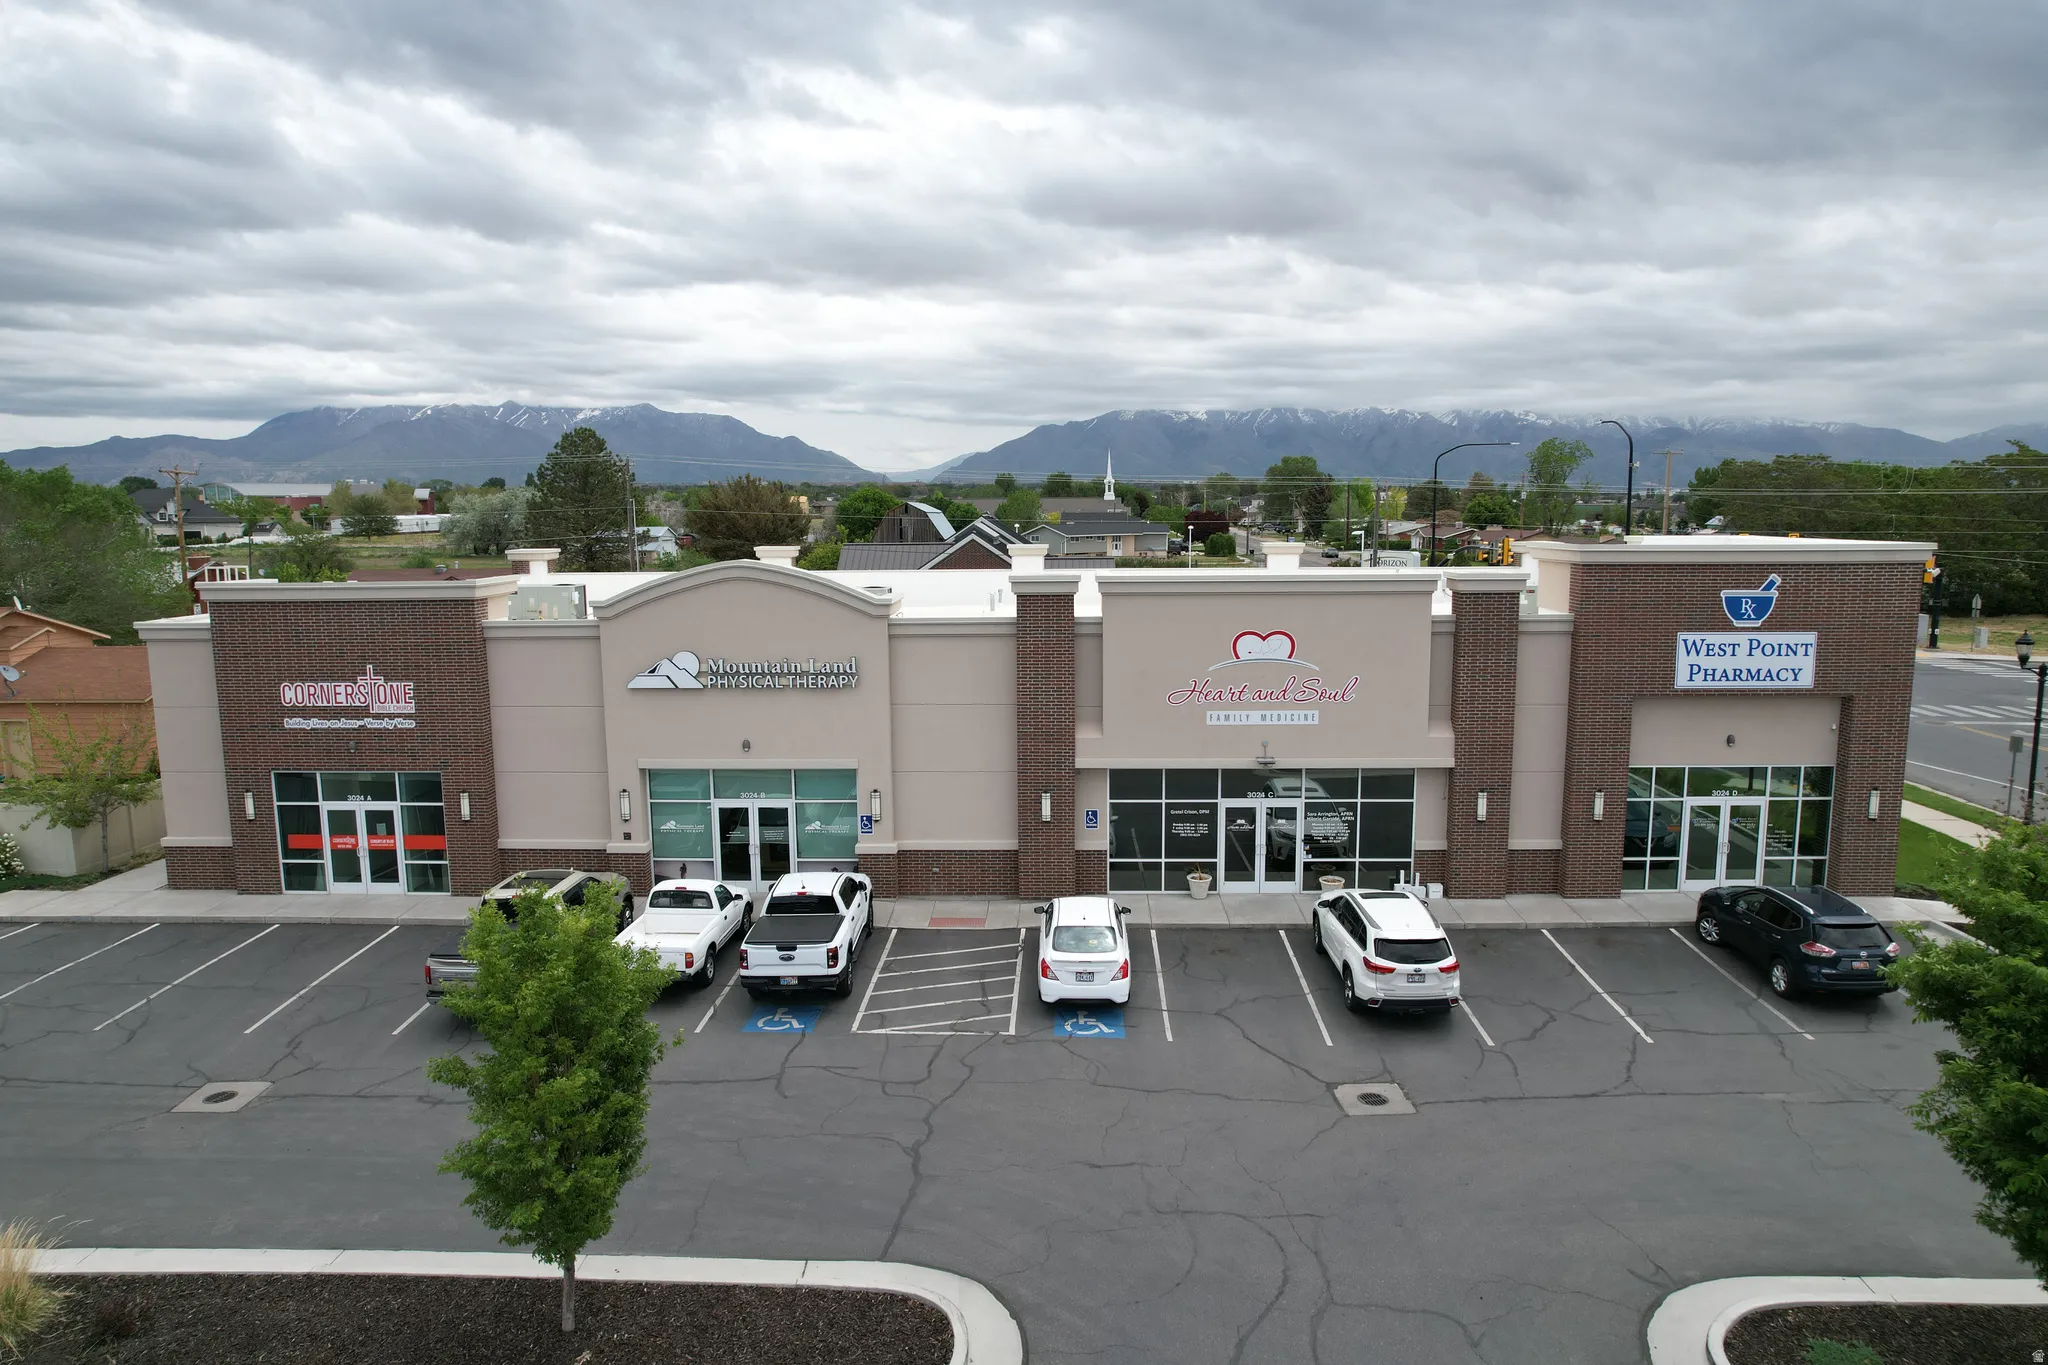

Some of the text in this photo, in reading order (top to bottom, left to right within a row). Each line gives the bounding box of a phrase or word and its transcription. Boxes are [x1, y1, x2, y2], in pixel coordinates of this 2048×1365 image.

[1377, 559, 1408, 567] ORIZON
[1681, 638, 1813, 657] WEST POINT
[706, 656, 857, 674] Mountain Land
[1687, 663, 1803, 682] PHARMACY
[707, 675, 859, 689] PHYSICAL THERAPY
[1167, 675, 1360, 706] Heart and Soul
[285, 718, 311, 729] Building
[312, 719, 328, 728] Lives
[340, 719, 358, 728] Jesus
[366, 719, 384, 728] Verse
[385, 719, 395, 730] by
[396, 719, 415, 728] Verse
[1209, 713, 1316, 722] FAMILY MEDICINE
